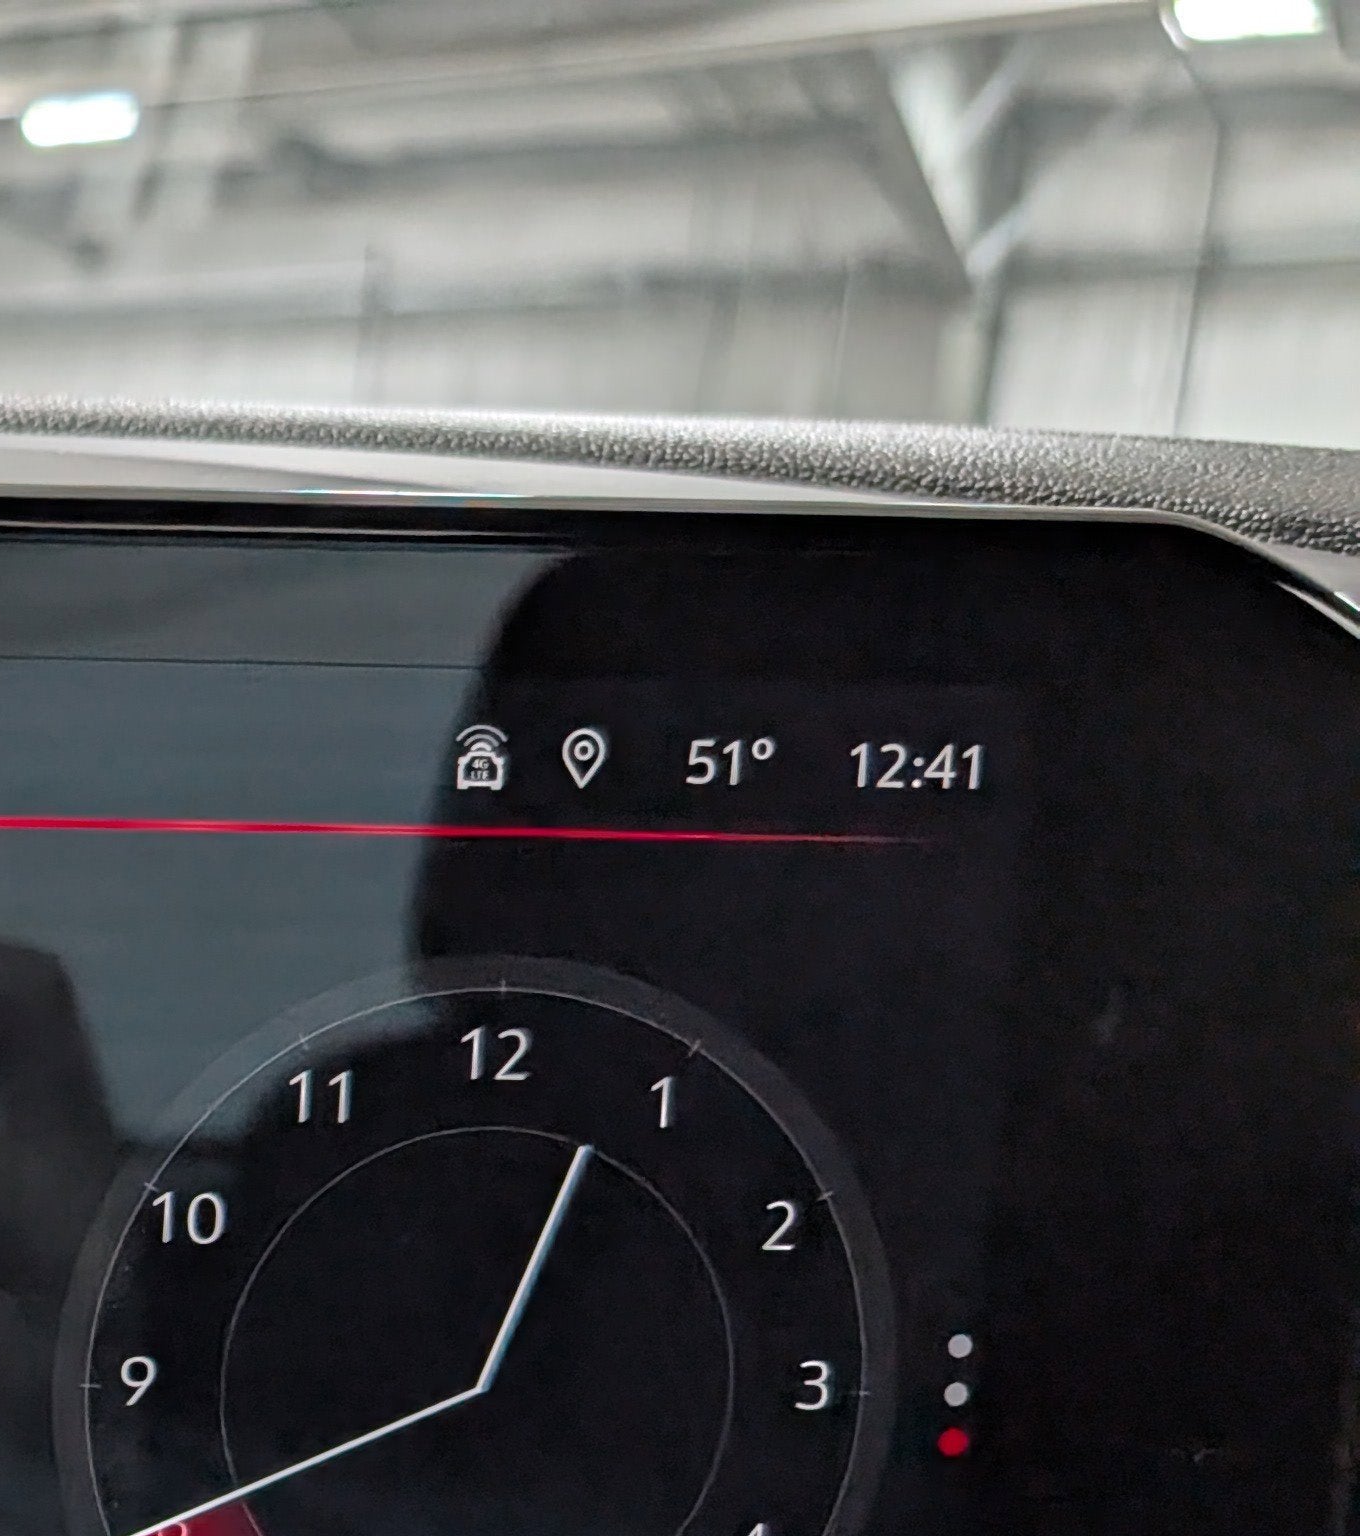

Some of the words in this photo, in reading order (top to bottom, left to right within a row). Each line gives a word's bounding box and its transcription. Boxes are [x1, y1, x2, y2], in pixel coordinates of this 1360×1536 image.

[685, 737, 776, 786] 51°
[849, 742, 984, 790] 12:41
[459, 1026, 532, 1082] 12
[288, 1069, 353, 1124] 11
[650, 1075, 676, 1129] 1
[152, 1191, 226, 1245] 10
[761, 1200, 798, 1251] 2
[120, 1355, 157, 1407] 9
[795, 1359, 832, 1411] 3
